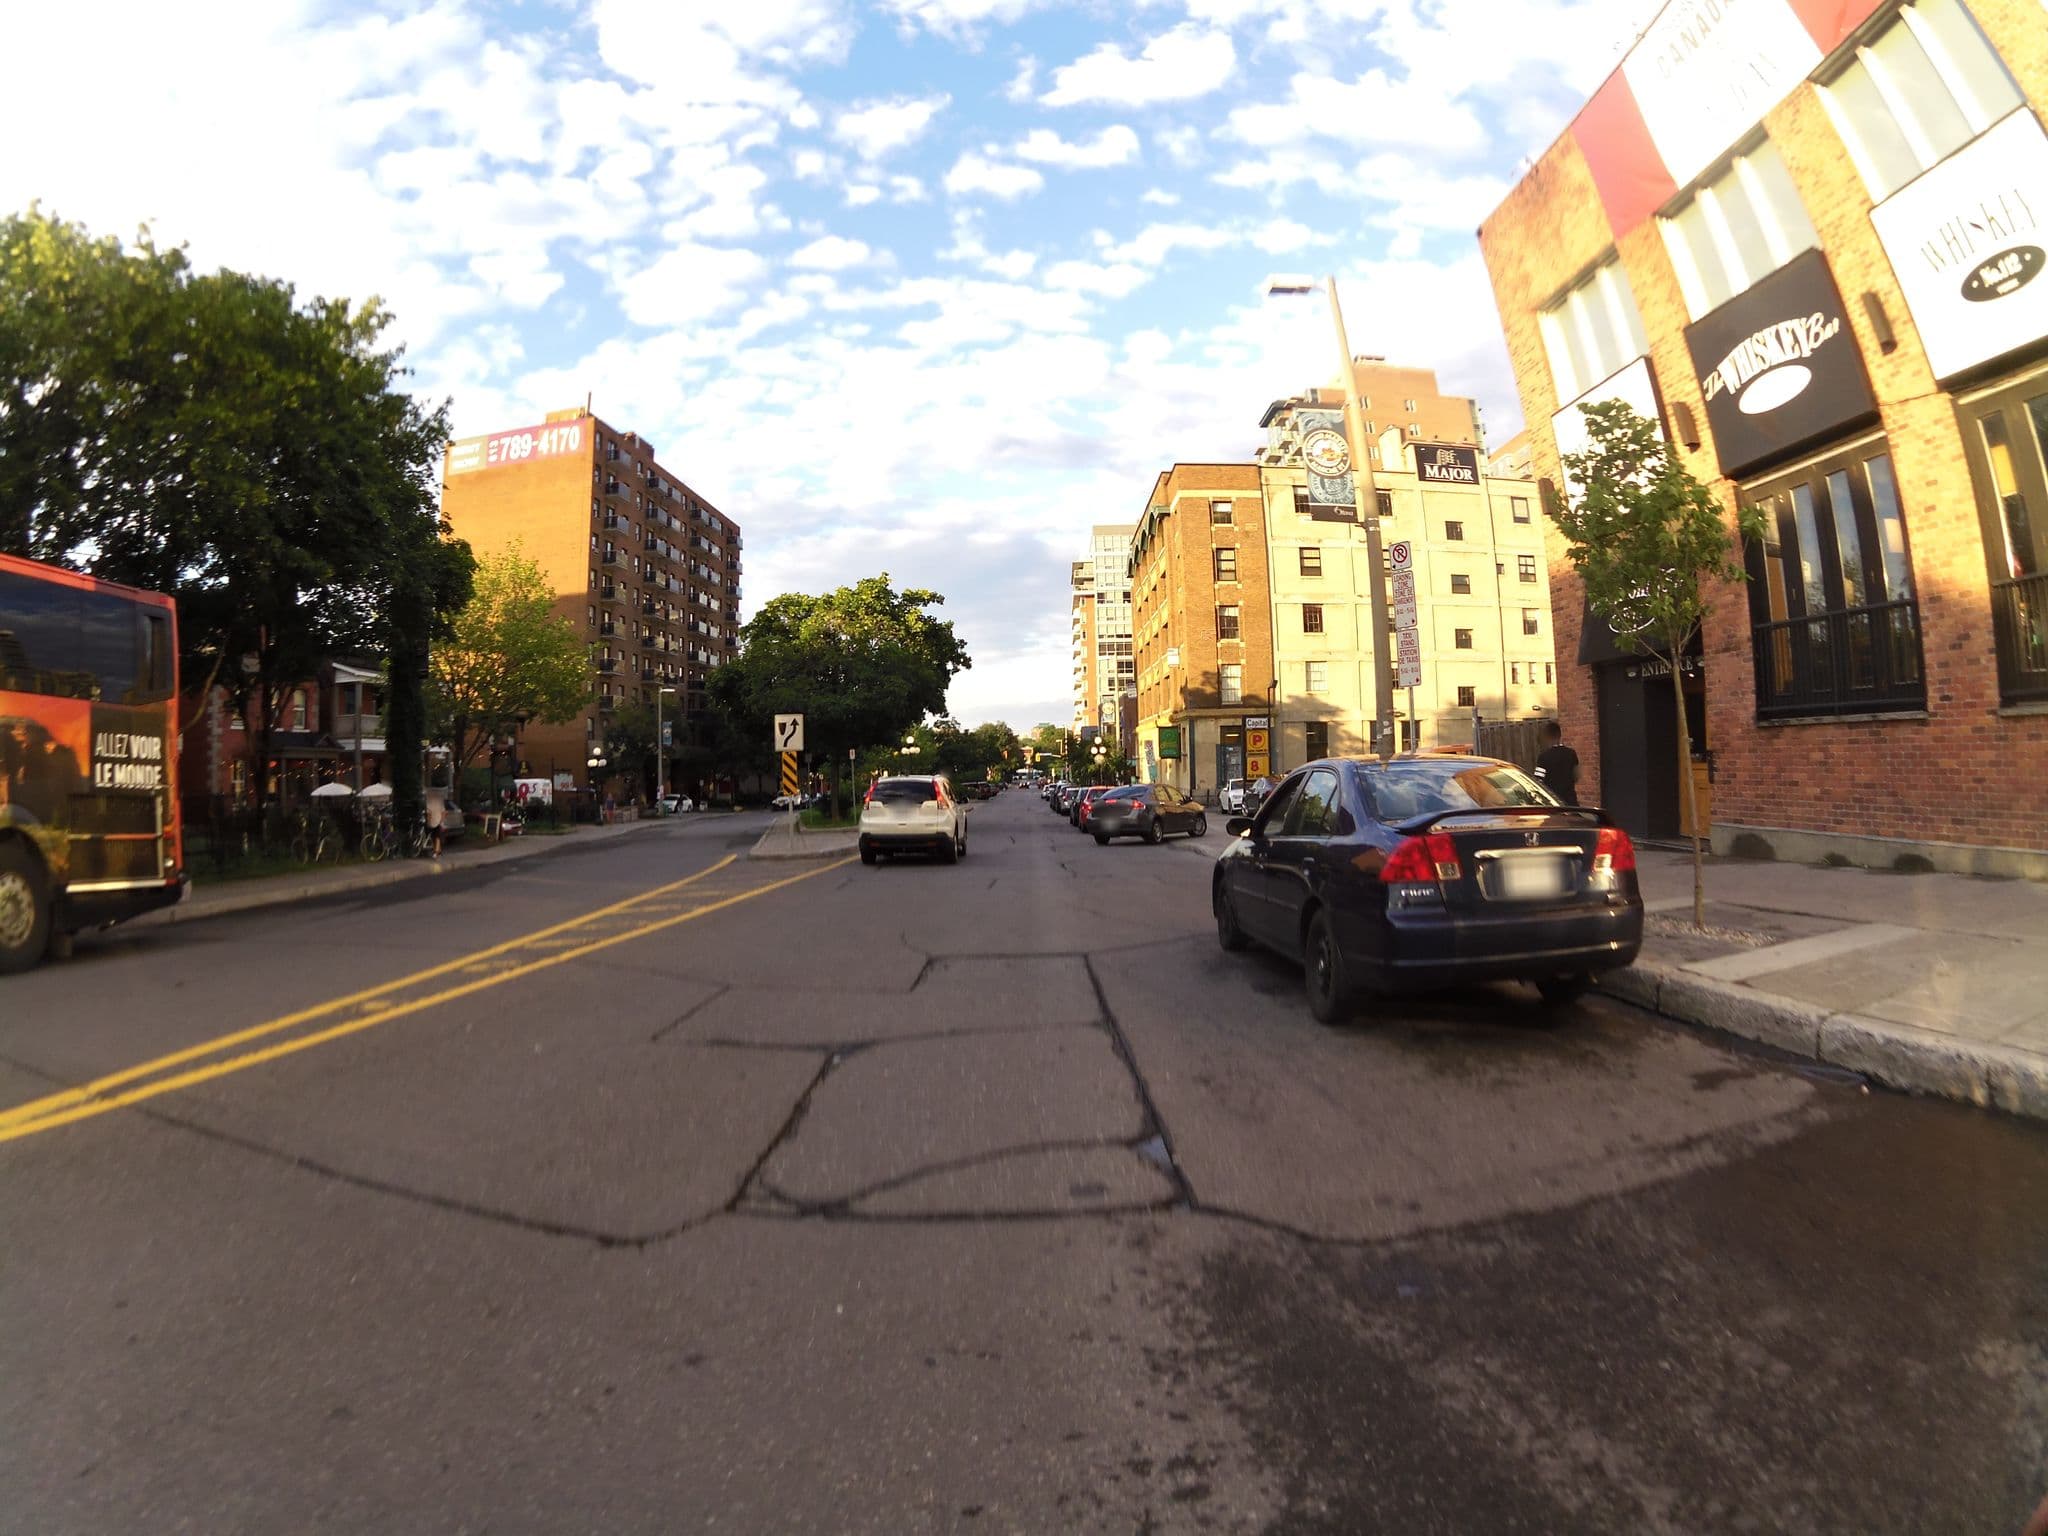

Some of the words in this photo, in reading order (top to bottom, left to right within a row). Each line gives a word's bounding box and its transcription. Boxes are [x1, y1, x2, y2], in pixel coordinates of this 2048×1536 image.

[1717, 317, 1812, 395] WHISKEY
[500, 425, 581, 462] 789-4170
[1424, 464, 1474, 481] MAJOR
[1399, 648, 1418, 657] STATION
[1247, 718, 1268, 727] Capital
[94, 732, 129, 758] ALLEZ
[129, 734, 162, 760] VOIR
[95, 762, 113, 788] LE
[114, 763, 163, 790] MONDE
